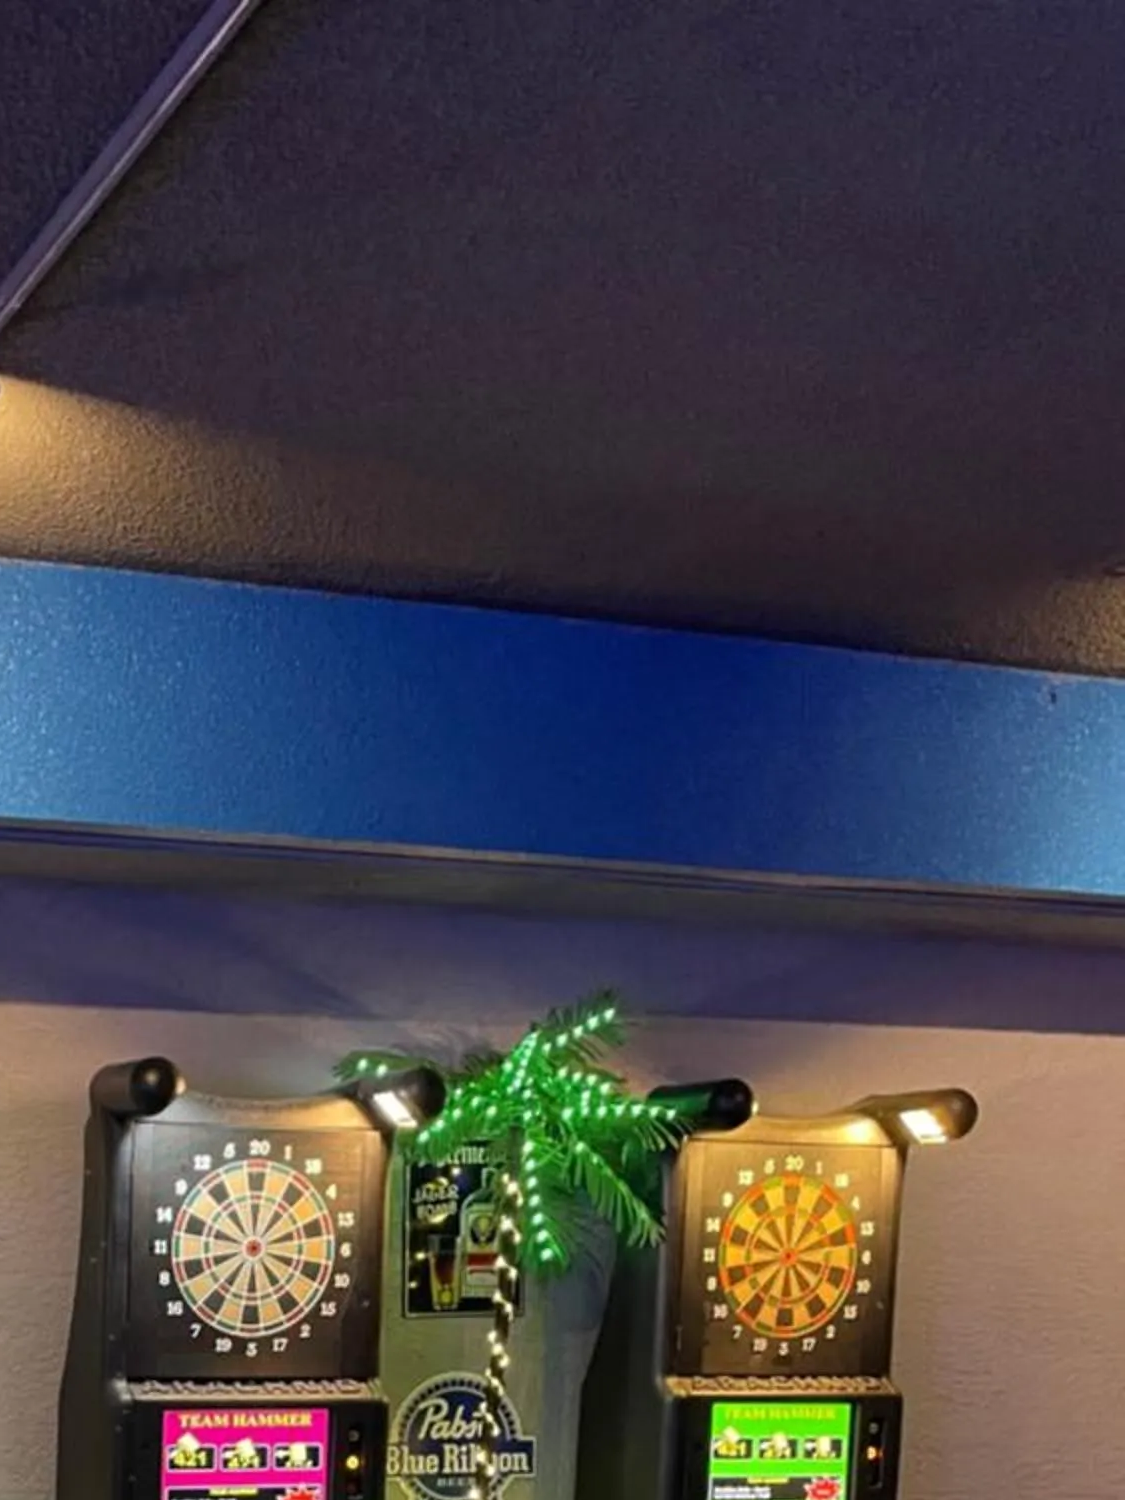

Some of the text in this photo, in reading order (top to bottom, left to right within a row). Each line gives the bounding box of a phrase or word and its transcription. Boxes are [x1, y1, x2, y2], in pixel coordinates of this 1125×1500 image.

[249, 1139, 271, 1156] 20
[325, 1183, 337, 1199] 4
[156, 1206, 173, 1223] 14
[154, 1239, 168, 1255] 11
[339, 1242, 352, 1258] 6
[334, 1276, 350, 1288] 10
[190, 1323, 202, 1338] 7
[299, 1323, 311, 1338] 2
[732, 1324, 743, 1339] 7
[272, 1337, 288, 1352] 17
[179, 1411, 313, 1428] TEAM HAMMER
[386, 1444, 439, 1475] Blue
